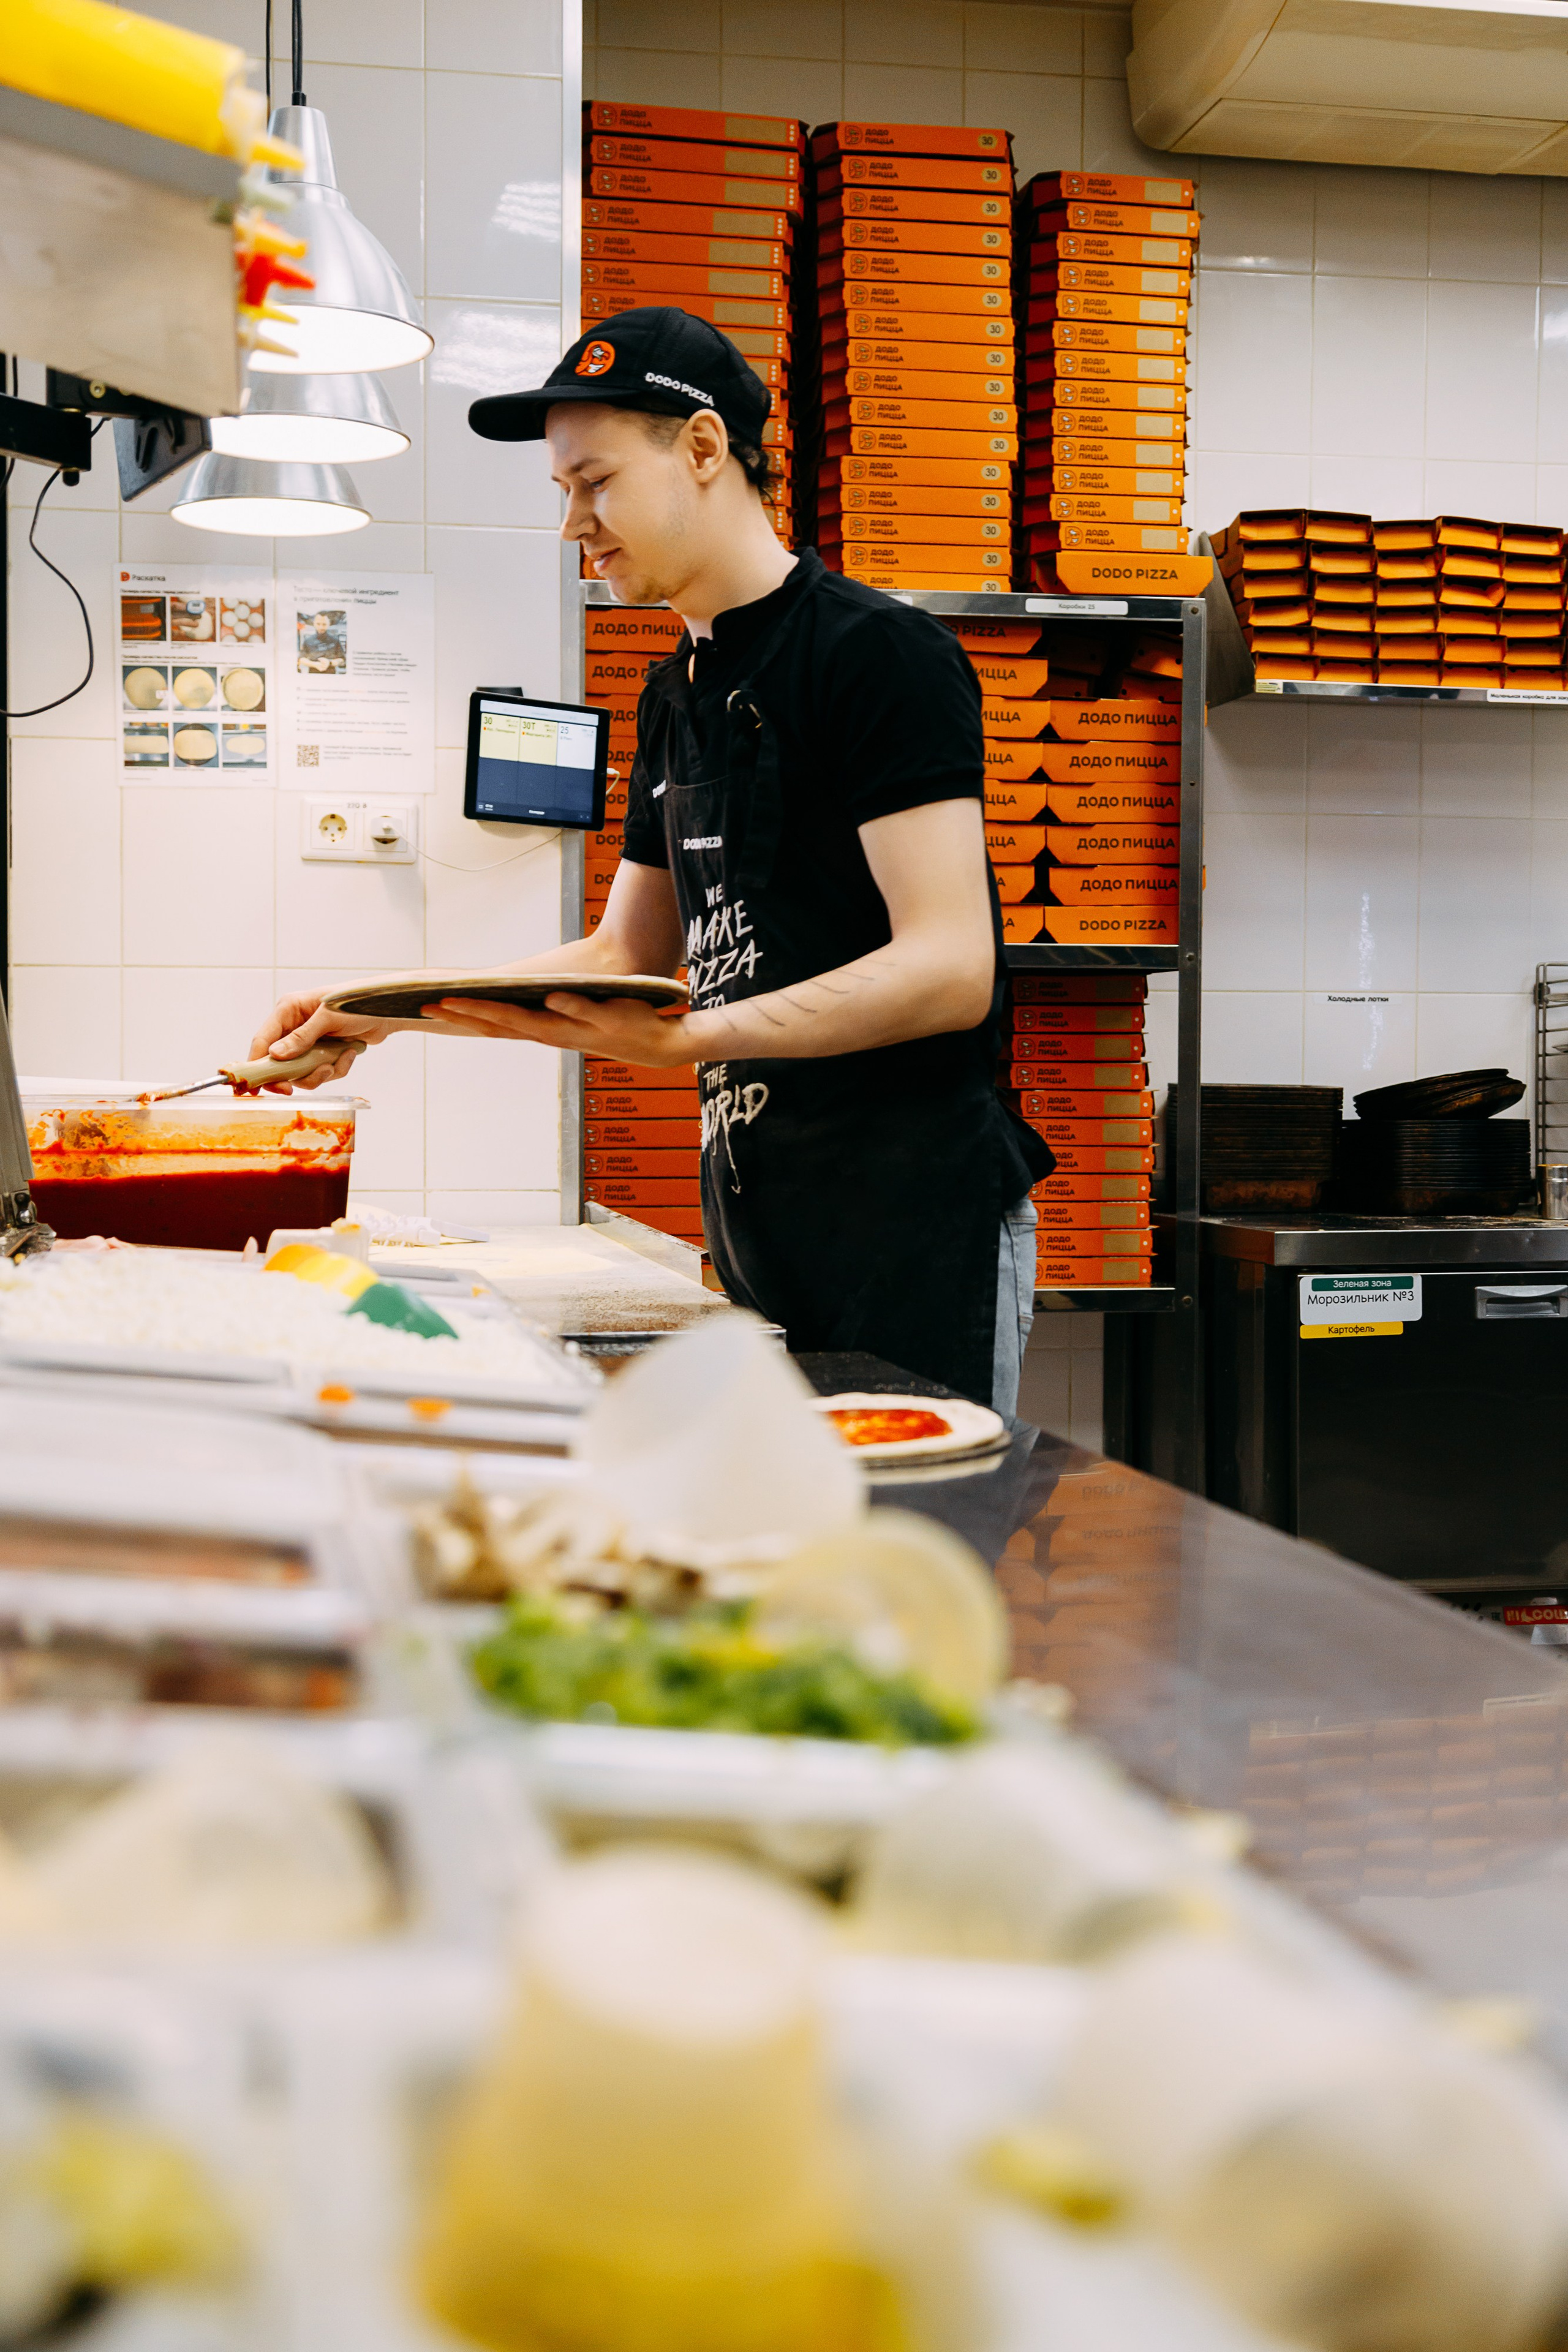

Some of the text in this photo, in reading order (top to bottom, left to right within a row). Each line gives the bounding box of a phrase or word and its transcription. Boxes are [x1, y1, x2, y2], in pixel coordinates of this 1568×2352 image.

[987, 170, 997, 179] 30
[987, 203, 996, 212] 30
[987, 235, 997, 244] 30
[987, 266, 997, 274] 30
[990, 325, 1000, 333] 30
[990, 354, 1001, 363] 30
[645, 372, 715, 407] DODO PIZZA
[990, 383, 1000, 391] 30
[993, 412, 1003, 420] 30
[986, 468, 996, 477] 30
[986, 497, 995, 506] 30
[986, 526, 996, 535] 30
[987, 555, 997, 564] 30
[1092, 568, 1178, 579] DODO PIZZA
[986, 583, 996, 592] 30
[593, 623, 687, 637] ДОДО ПИЦЦ
[962, 627, 1006, 637] PIZZA
[592, 666, 637, 679] ДОДО
[975, 668, 1017, 680] ИЦЦА
[981, 711, 1021, 722] ИЦЦА
[1079, 713, 1177, 726] ДОДО ПИЦЦА
[1069, 756, 1167, 769] ДОДО ПИЦЦА
[1077, 797, 1174, 809] ДОДО ПИЦЦА
[596, 834, 626, 845] DOD
[1077, 839, 1175, 850] ДОДО ПИЦЦА
[1080, 880, 1178, 891] ДОДО ПИЦЦА
[705, 883, 723, 908] WE
[687, 900, 753, 960] MAKE
[1080, 920, 1167, 930] DODO PIZZA
[704, 1064, 727, 1093] THE
[1333, 1280, 1369, 1288] Зеленая
[1307, 1291, 1414, 1306] Морозильник №3
[1328, 1325, 1375, 1335] Картофель
